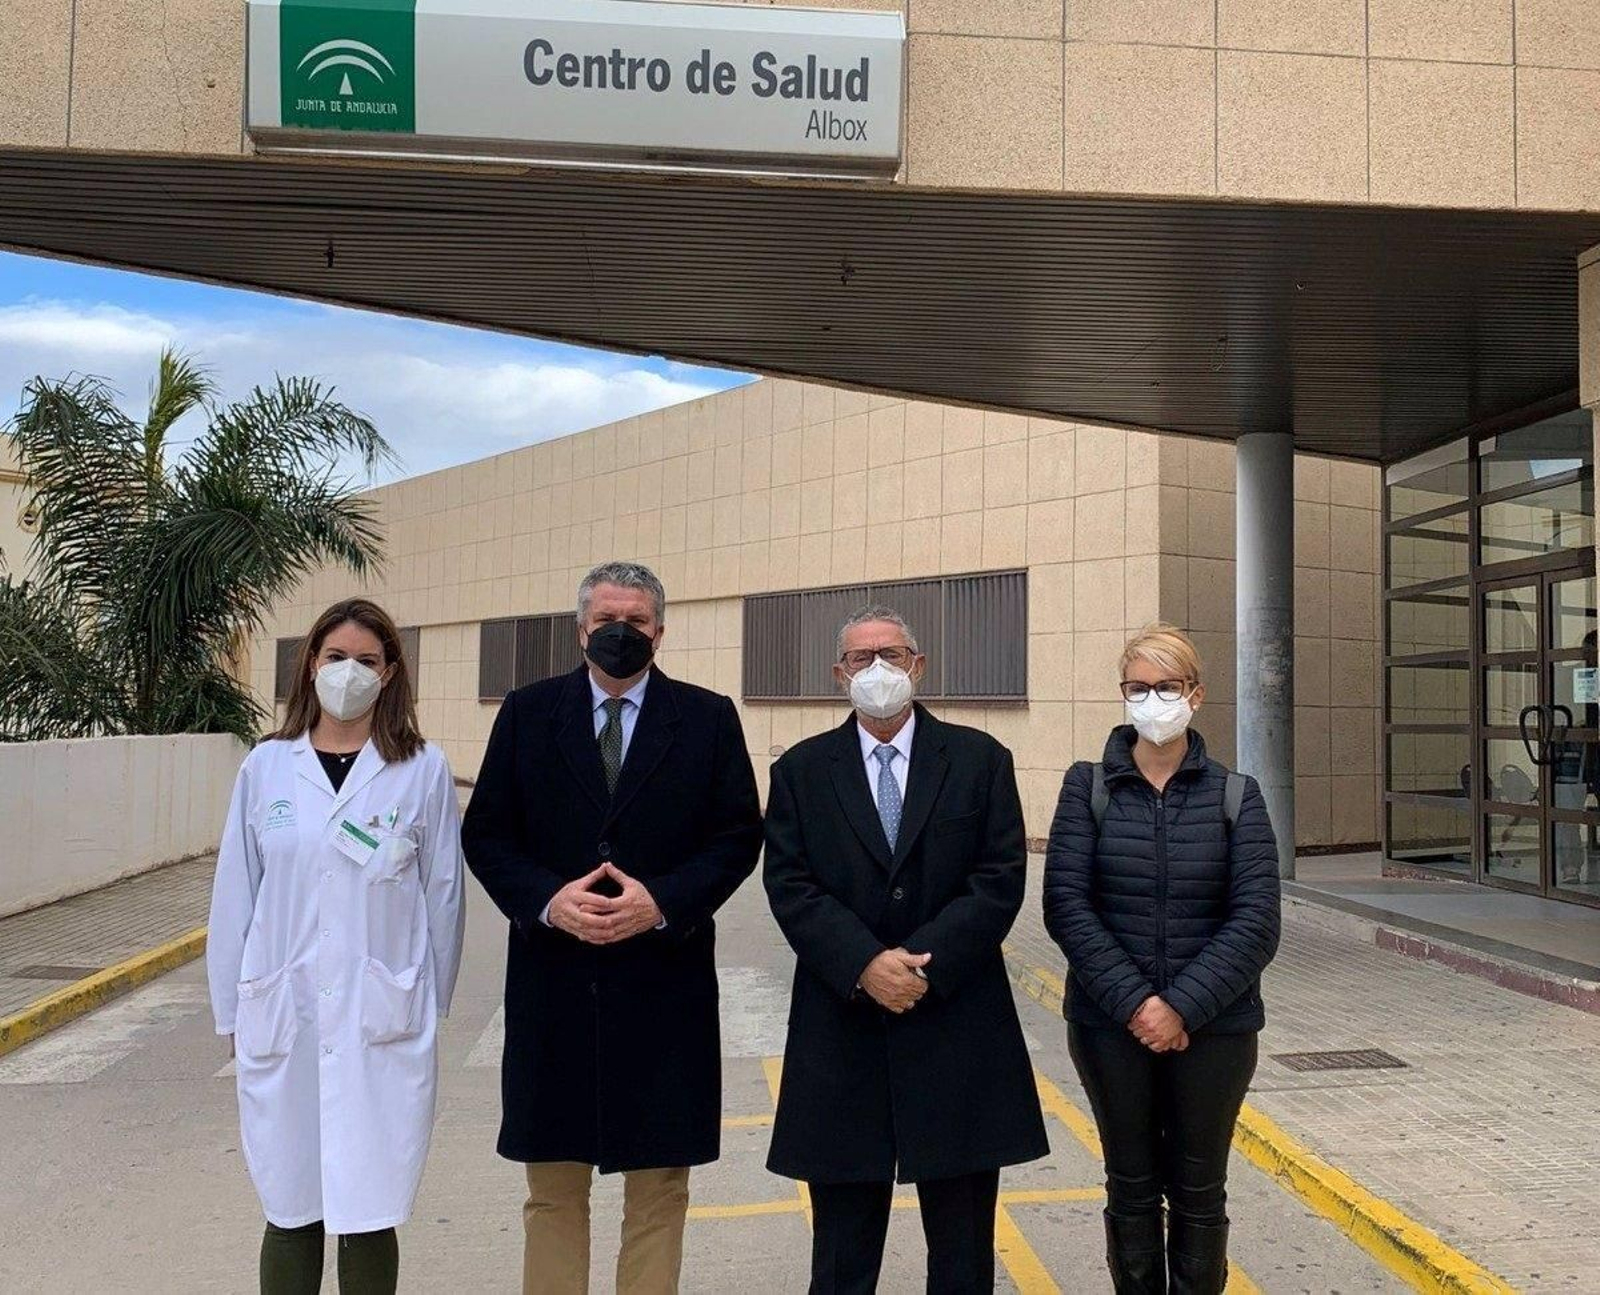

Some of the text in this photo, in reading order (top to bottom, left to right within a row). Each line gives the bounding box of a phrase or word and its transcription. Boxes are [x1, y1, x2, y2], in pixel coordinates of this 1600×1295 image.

[523, 38, 869, 102] Centro de Salud
[295, 99, 326, 112] JUNTA
[330, 101, 342, 113] DE
[805, 109, 868, 141] Albox
